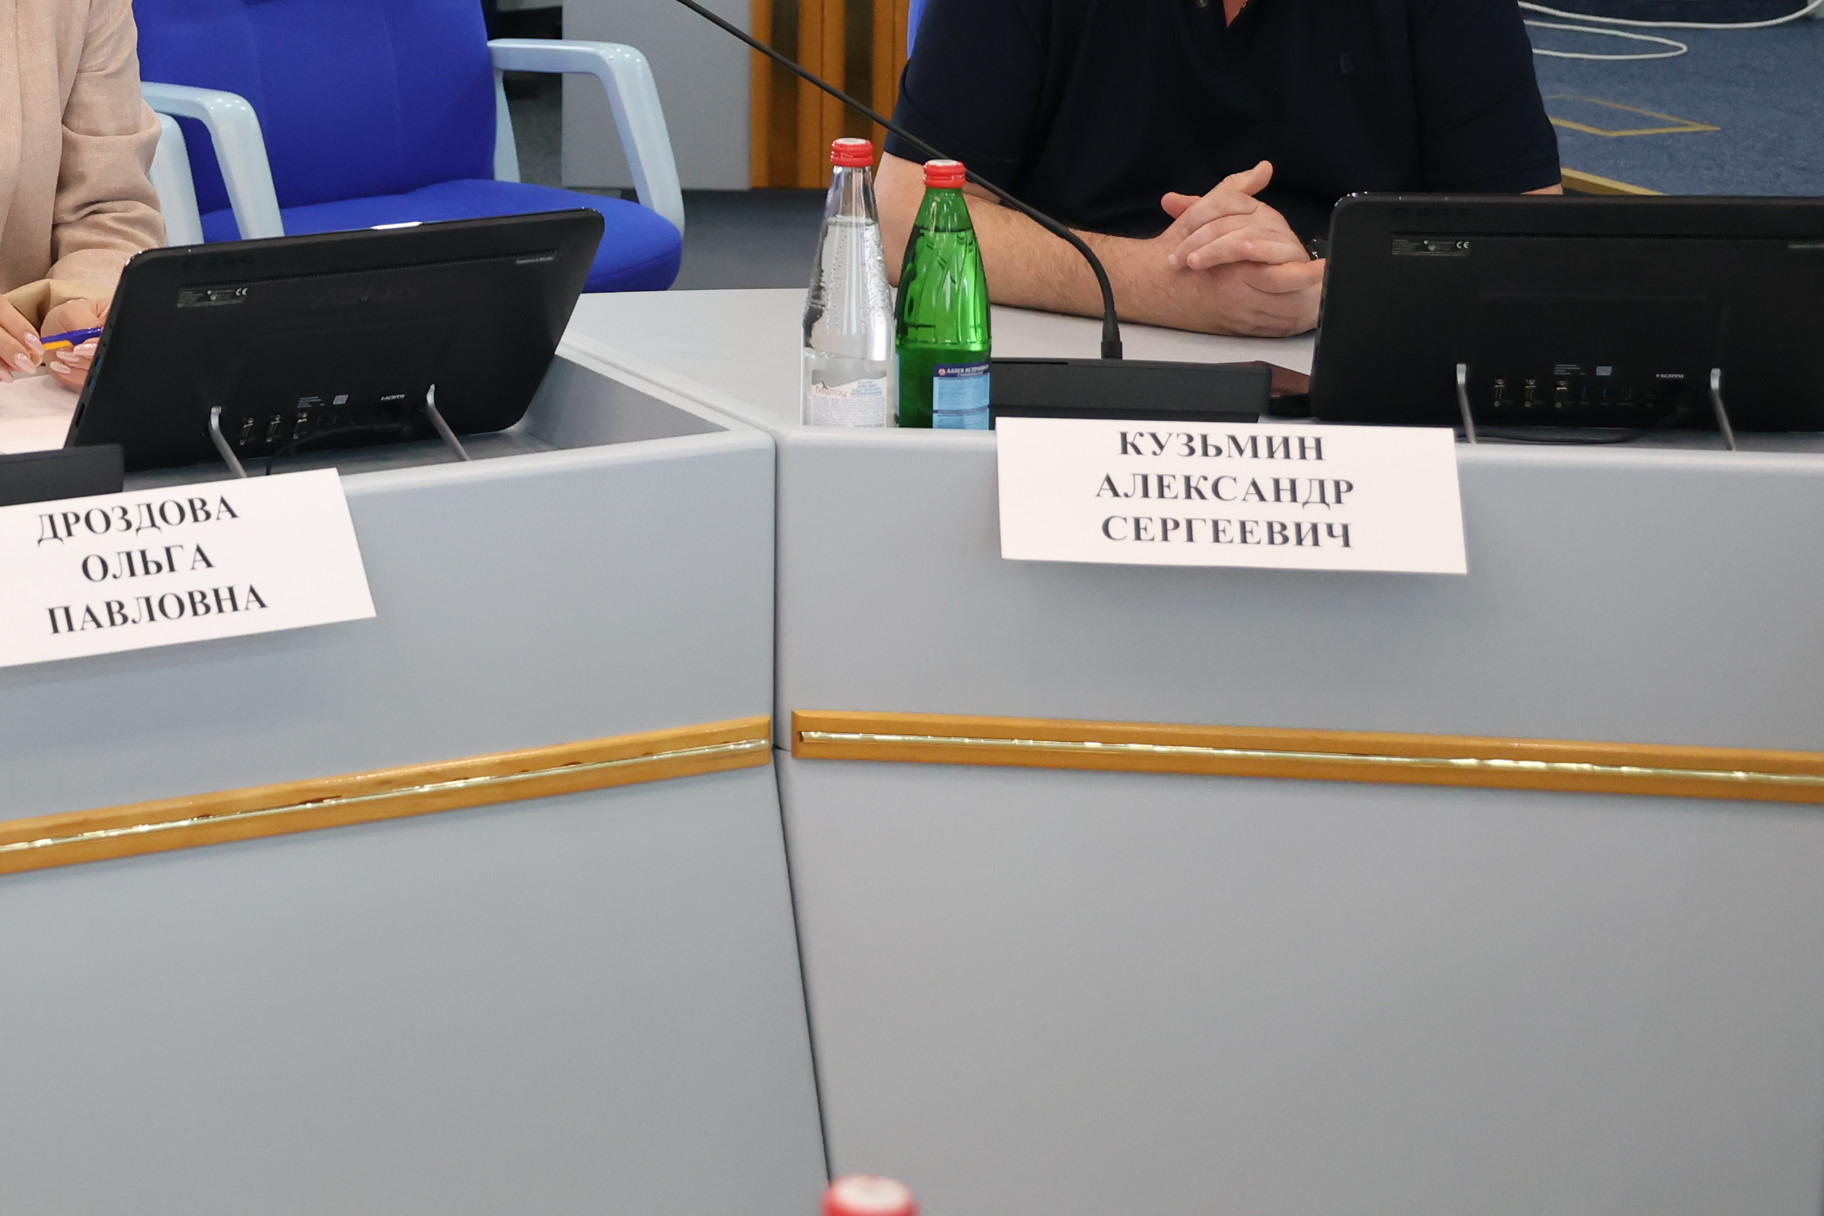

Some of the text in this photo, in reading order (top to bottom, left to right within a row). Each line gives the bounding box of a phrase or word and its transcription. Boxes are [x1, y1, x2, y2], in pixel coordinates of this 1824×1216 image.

[1118, 430, 1325, 461] КУЗЬМИН
[1095, 472, 1354, 509] АЛЕКСАНДР
[36, 495, 240, 547] ДРОЗДОВА
[1101, 515, 1352, 548] СЕРГЕЕВИЧ
[81, 543, 215, 583] ОЛЬГА
[47, 583, 269, 635] ПАВЛОВНА
